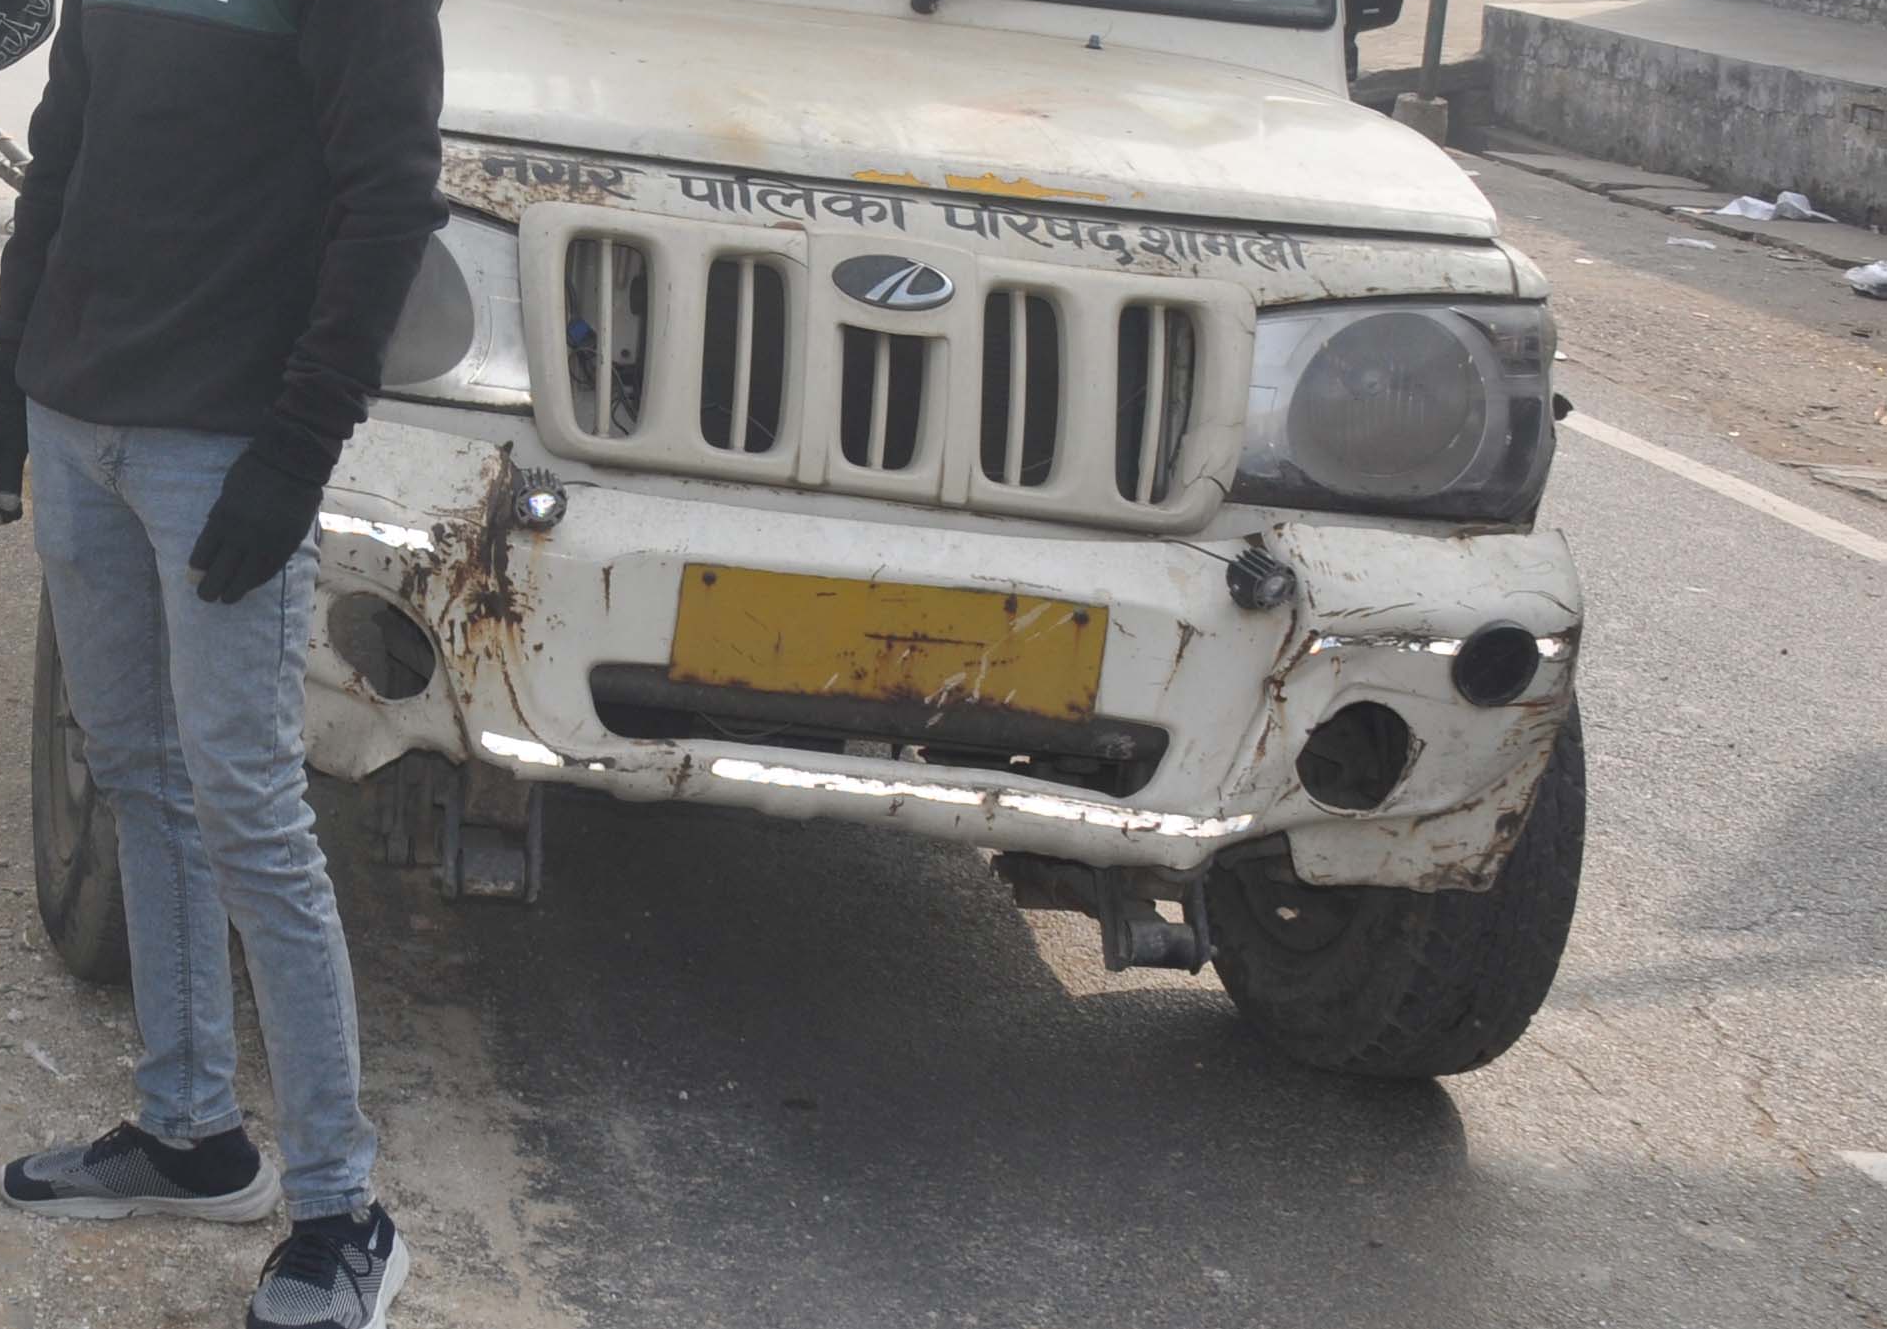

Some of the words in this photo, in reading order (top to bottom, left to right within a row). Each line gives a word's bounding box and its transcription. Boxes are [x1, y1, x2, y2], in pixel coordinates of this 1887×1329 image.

[480, 151, 647, 201] नगर
[668, 173, 919, 232] पालिका
[1137, 224, 1313, 272] शामली
